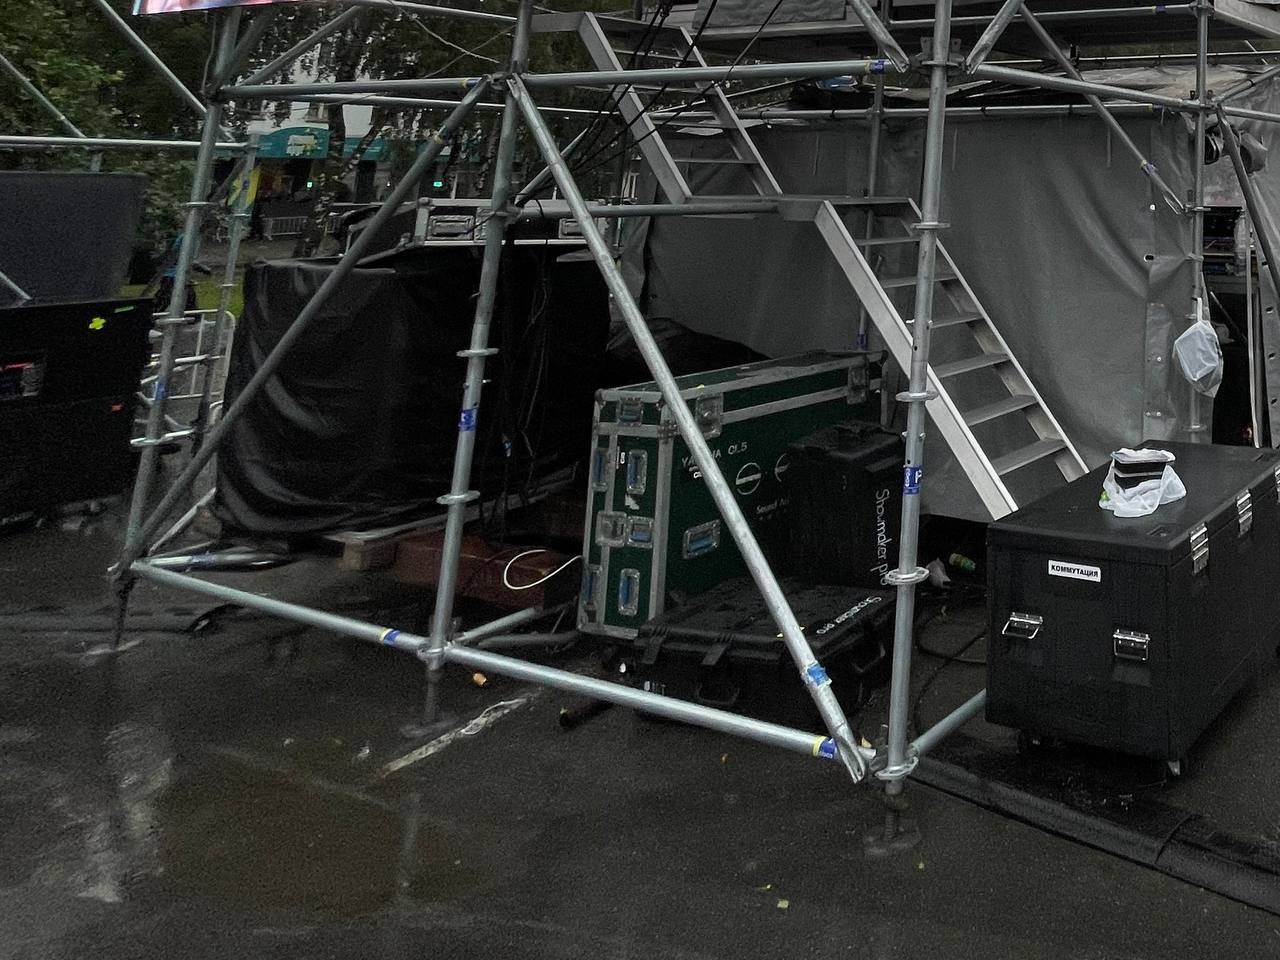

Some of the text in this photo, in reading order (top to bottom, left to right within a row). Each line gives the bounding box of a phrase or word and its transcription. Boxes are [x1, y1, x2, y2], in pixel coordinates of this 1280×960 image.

[727, 441, 748, 455] CL5
[876, 489, 893, 560] Showmaker
[1051, 564, 1099, 578] КОММУТАЦИЯ
